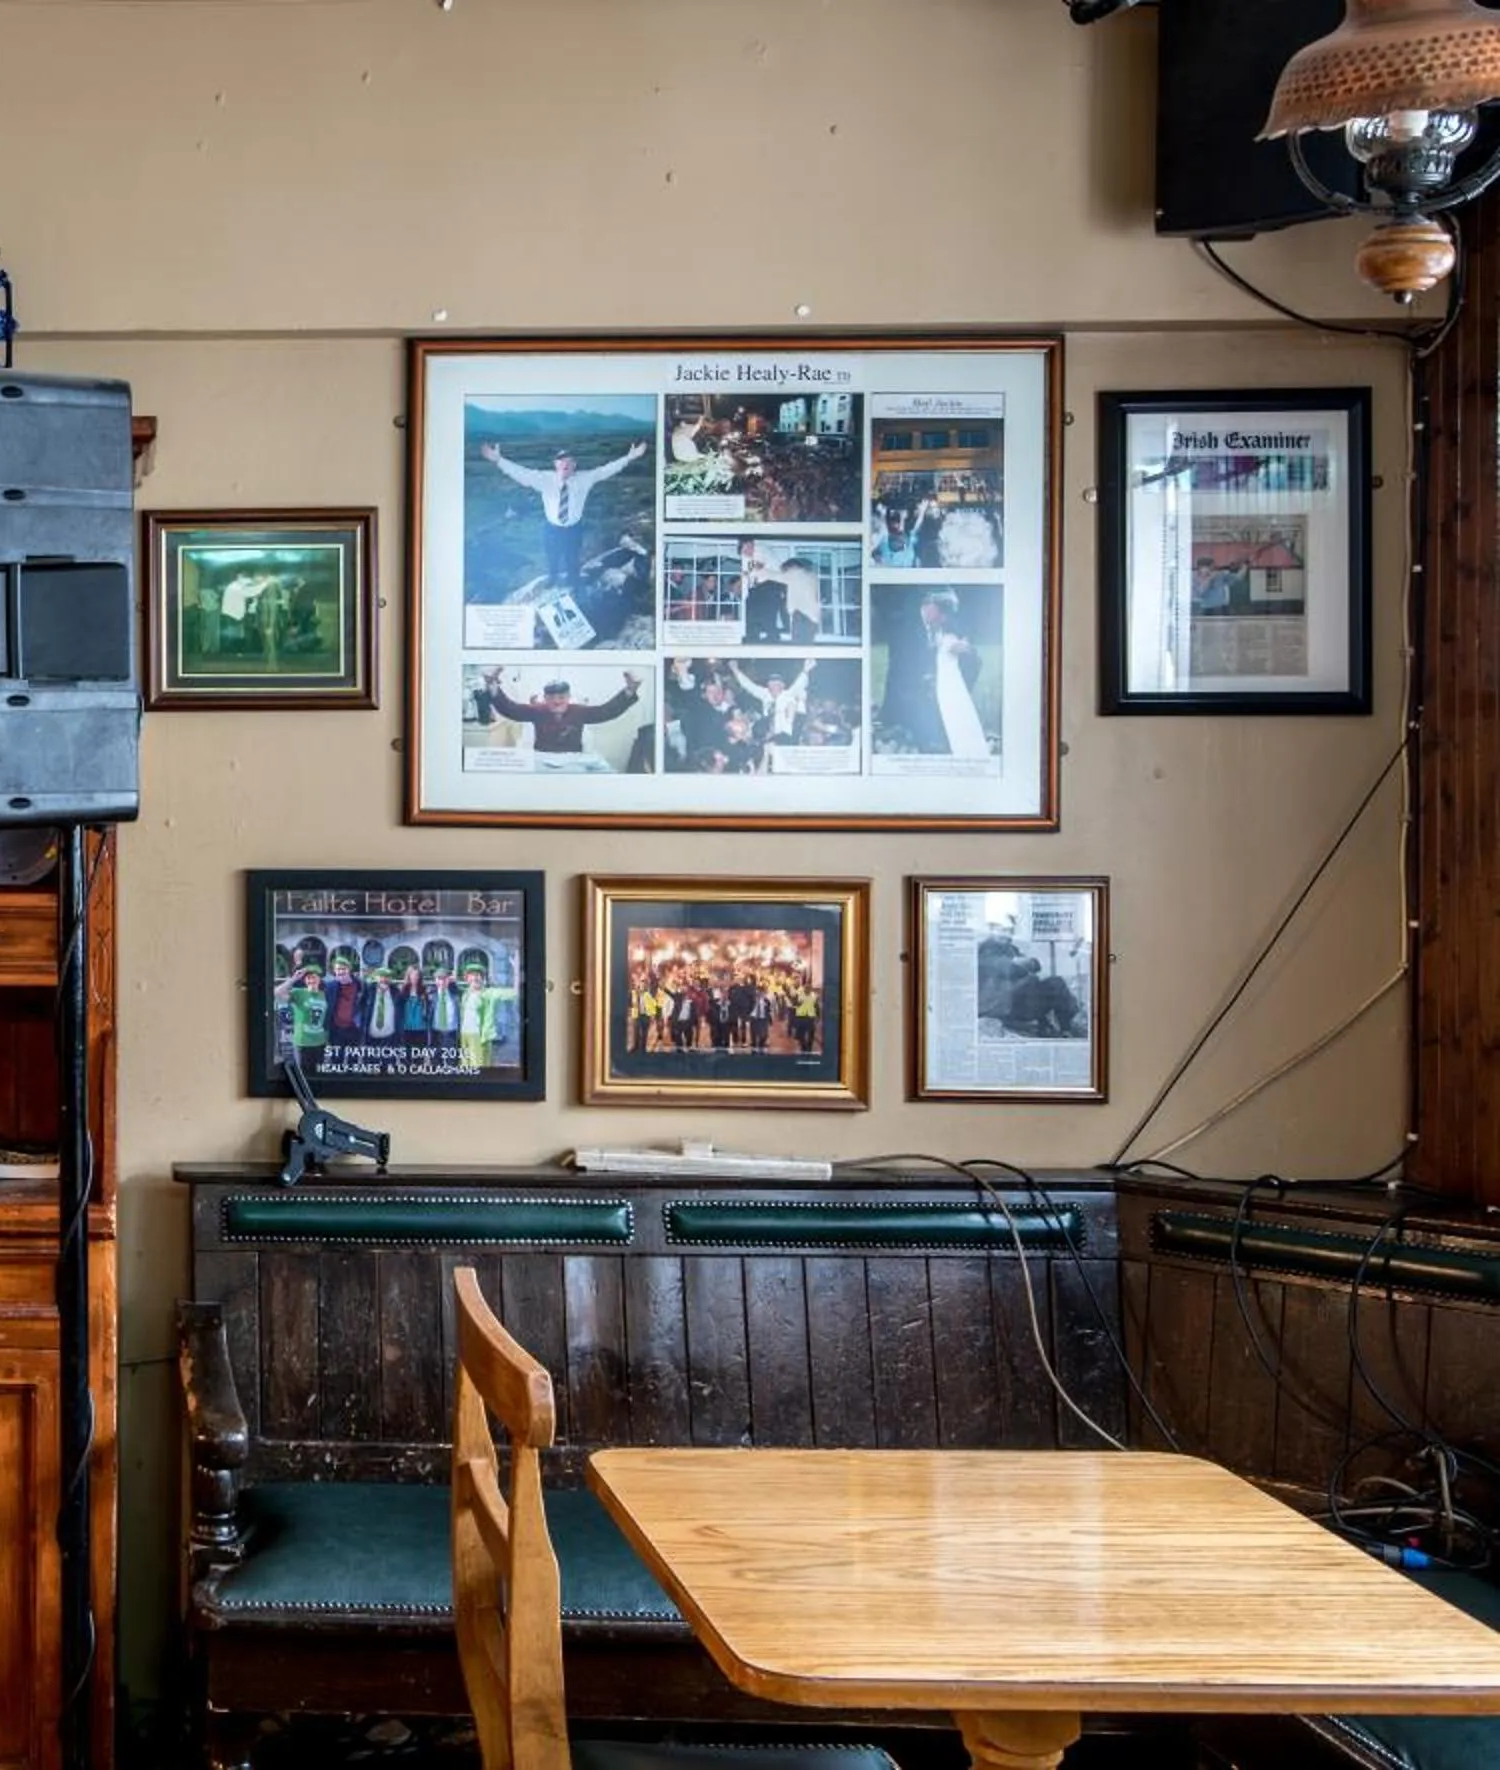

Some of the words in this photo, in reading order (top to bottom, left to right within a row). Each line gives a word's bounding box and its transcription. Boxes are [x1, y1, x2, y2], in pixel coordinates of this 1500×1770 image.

[675, 364, 731, 381] Jackie
[736, 364, 833, 385] Healy-Rae
[1173, 432, 1219, 449] Irish
[1224, 432, 1311, 449] Examiner
[365, 890, 440, 913] Hotel
[467, 891, 514, 914] Bar
[324, 1045, 341, 1057] ST
[411, 1047, 437, 1058] DAY
